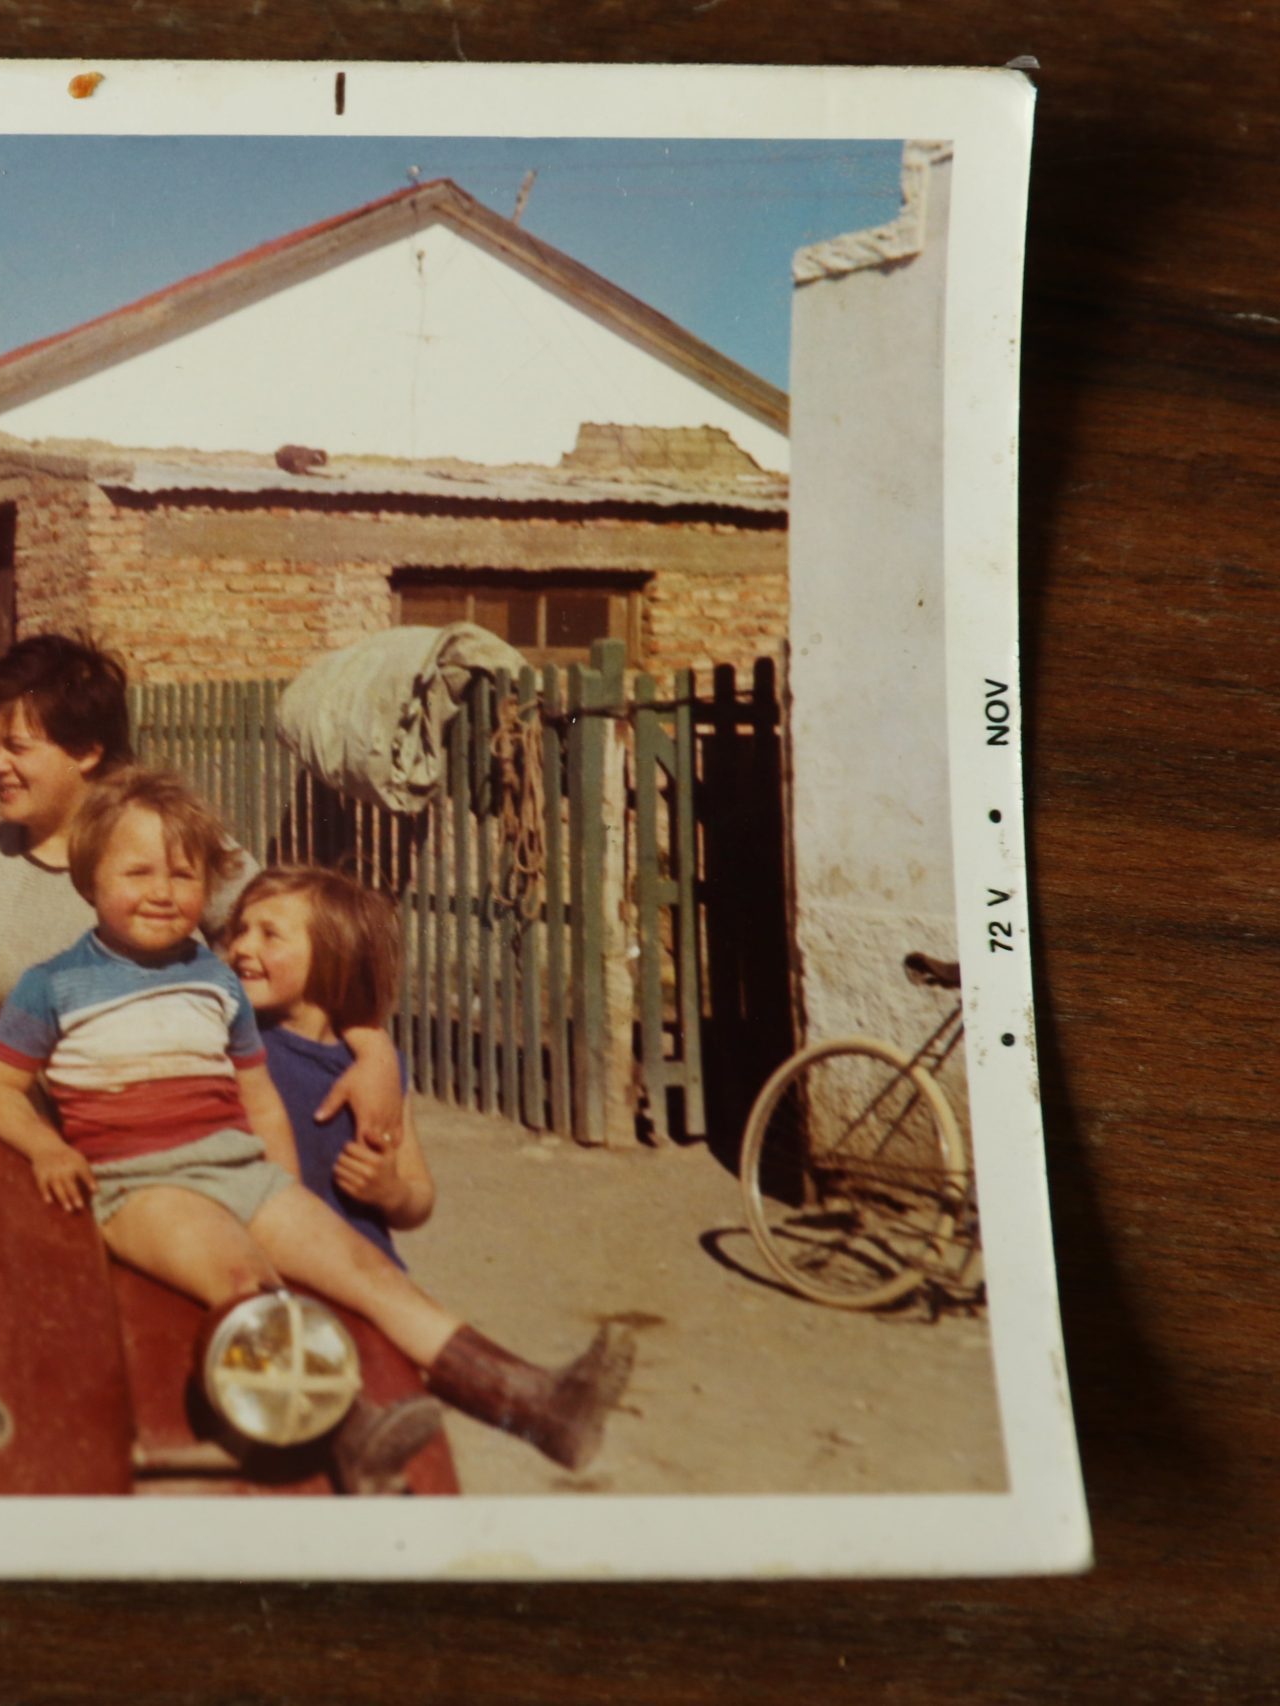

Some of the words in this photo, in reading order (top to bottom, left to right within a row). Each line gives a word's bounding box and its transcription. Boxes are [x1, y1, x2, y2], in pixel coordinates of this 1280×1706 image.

[984, 678, 1010, 746] NOV
[986, 888, 1012, 907] V
[987, 921, 1014, 953] 72
